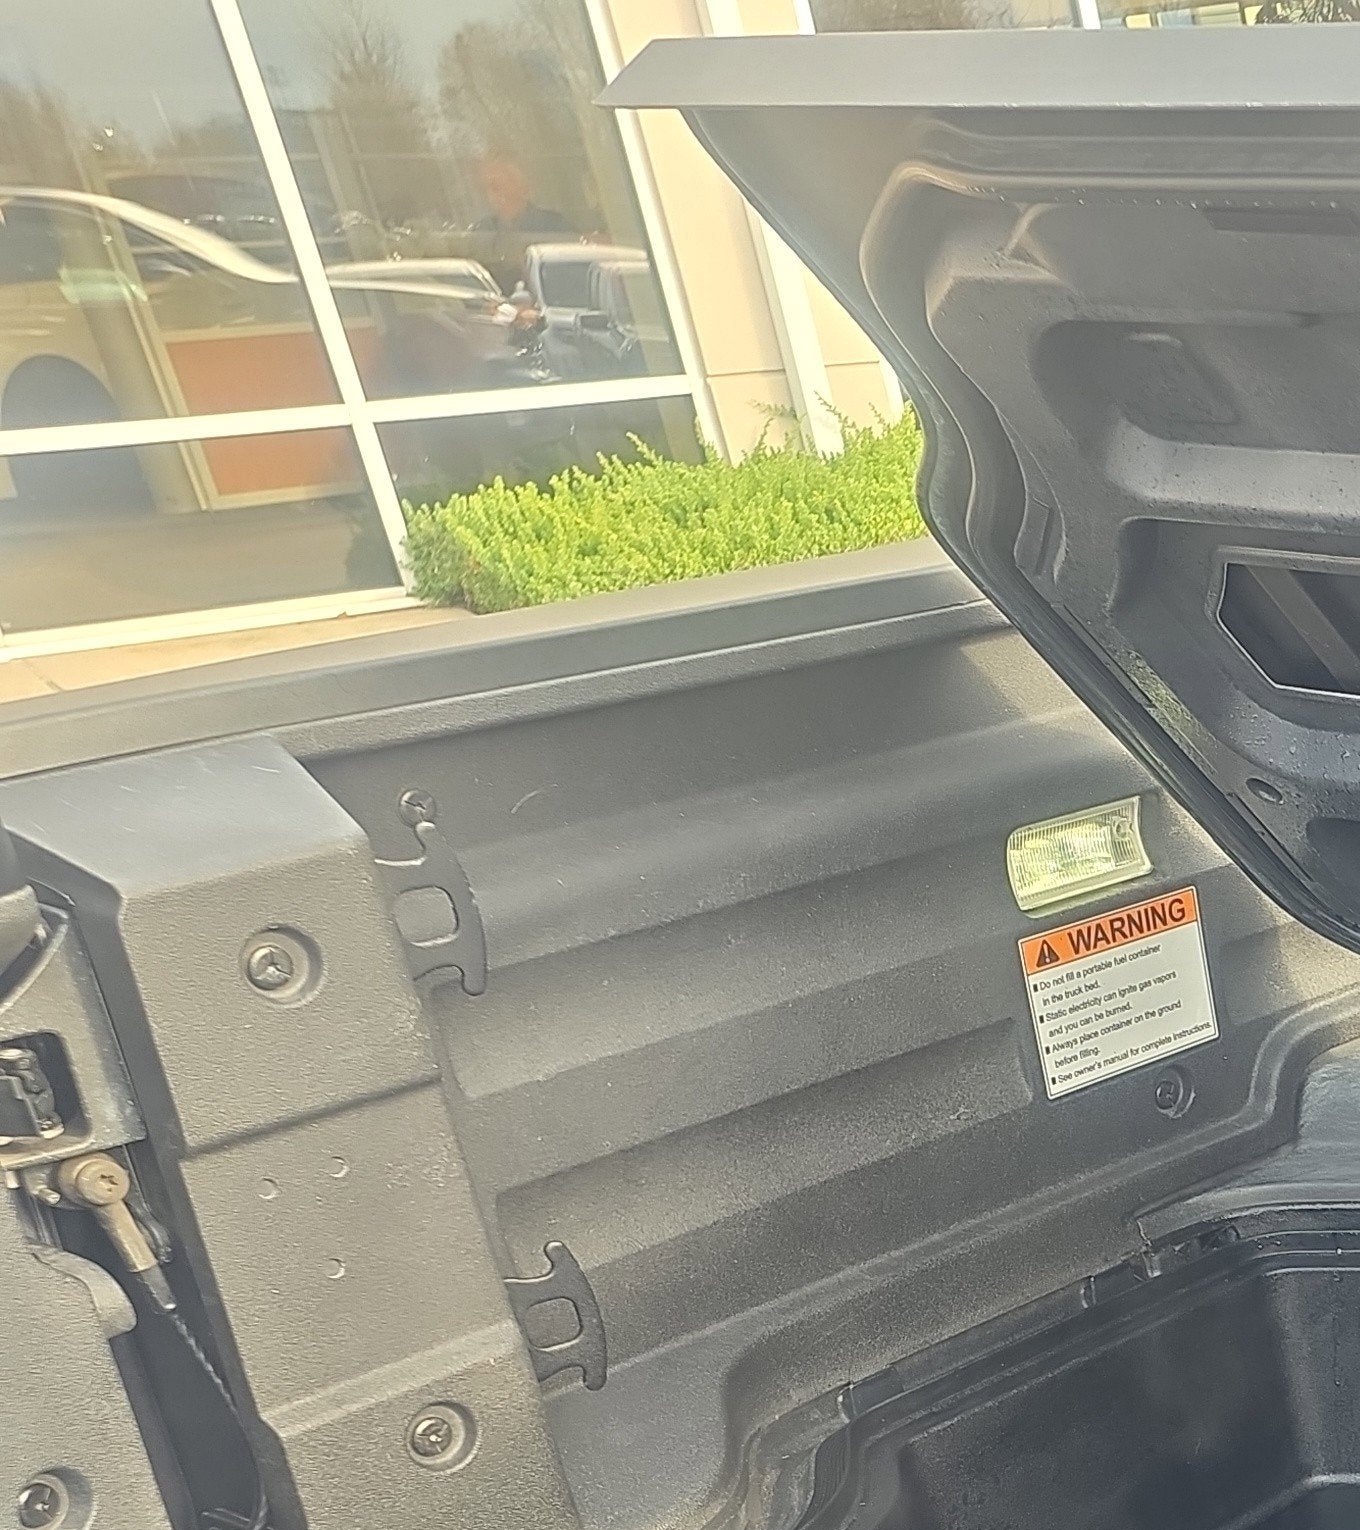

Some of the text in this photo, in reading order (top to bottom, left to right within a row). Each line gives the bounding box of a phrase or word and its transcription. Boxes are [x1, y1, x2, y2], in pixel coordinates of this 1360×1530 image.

[1066, 898, 1186, 955] WARNING
[1040, 981, 1051, 991] Do
[1053, 976, 1065, 986] not
[1065, 971, 1075, 981] fill
[1082, 960, 1113, 978] portable
[1113, 954, 1128, 966] fuel
[1128, 944, 1161, 961] container
[1042, 980, 1101, 1006] in the truck bed.
[1045, 971, 1177, 1021] Static electricity can ignite gas vapors
[1049, 1001, 1133, 1037] and you can be burned.
[1052, 999, 1182, 1053] Always place container on the ground
[1054, 1047, 1101, 1068] before filling.
[1058, 1021, 1212, 1083] See owner's manual for complete instructions.
